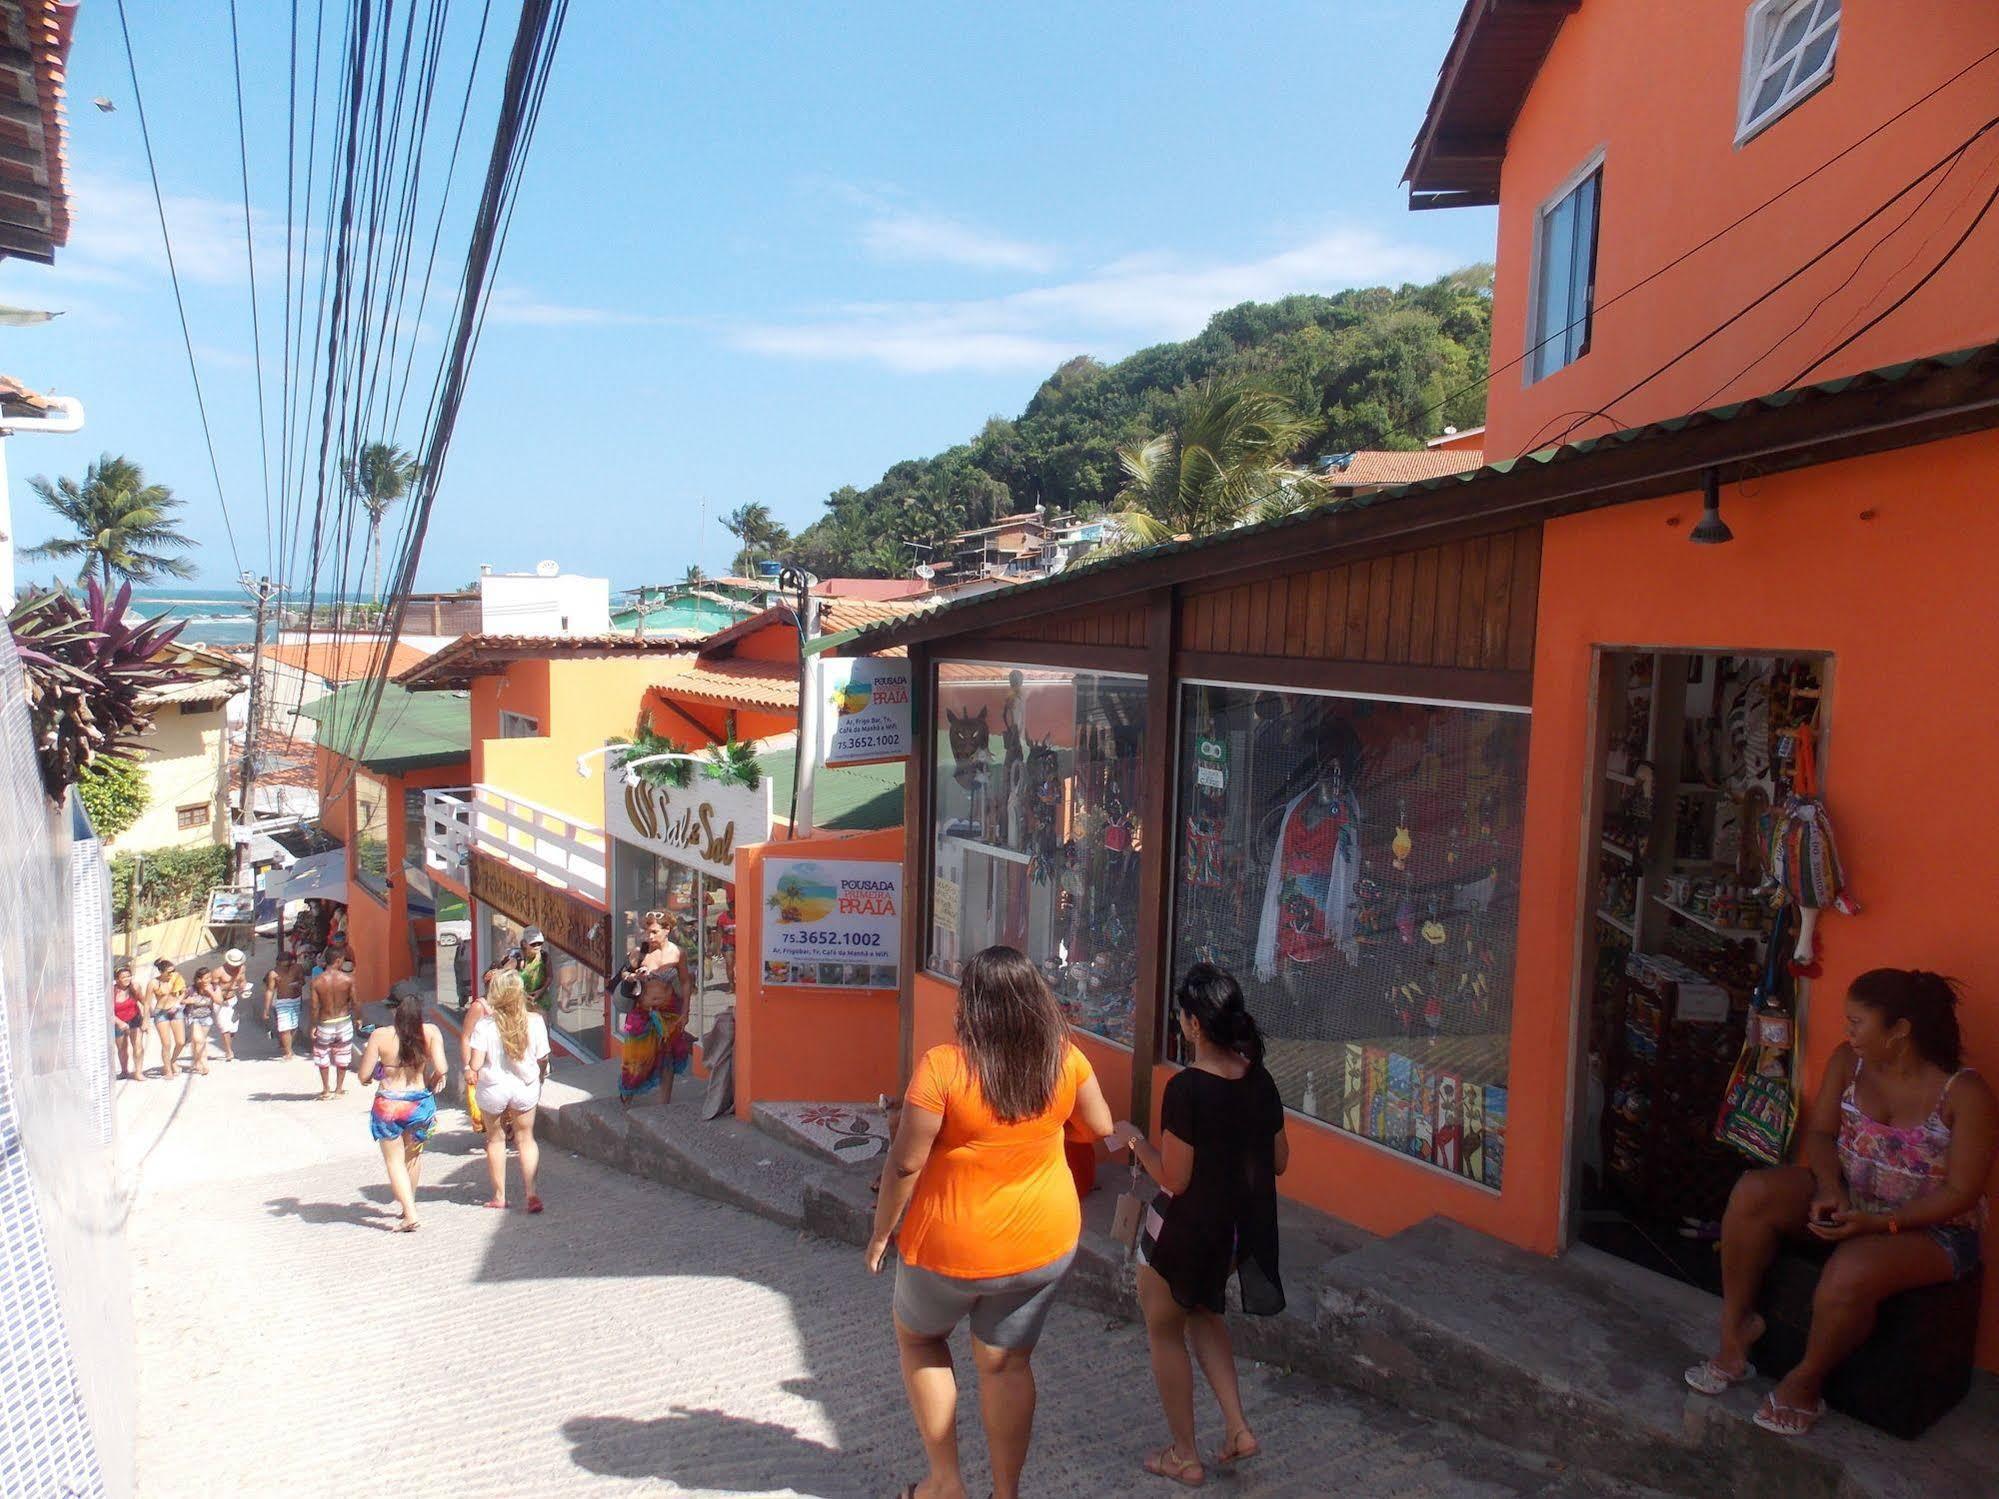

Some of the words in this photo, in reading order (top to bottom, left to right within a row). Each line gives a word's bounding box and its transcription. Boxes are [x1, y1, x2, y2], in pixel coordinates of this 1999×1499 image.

[874, 676, 907, 686] POUSADA
[873, 691, 909, 704] PRAIA
[838, 735, 899, 749] 75.3652.1002
[699, 802, 734, 866] Sol
[841, 880, 895, 891] POUSADA
[844, 889, 892, 900] PRIMEIRA
[838, 898, 896, 916] PRAIA
[782, 930, 881, 946] 75.3652.1002
